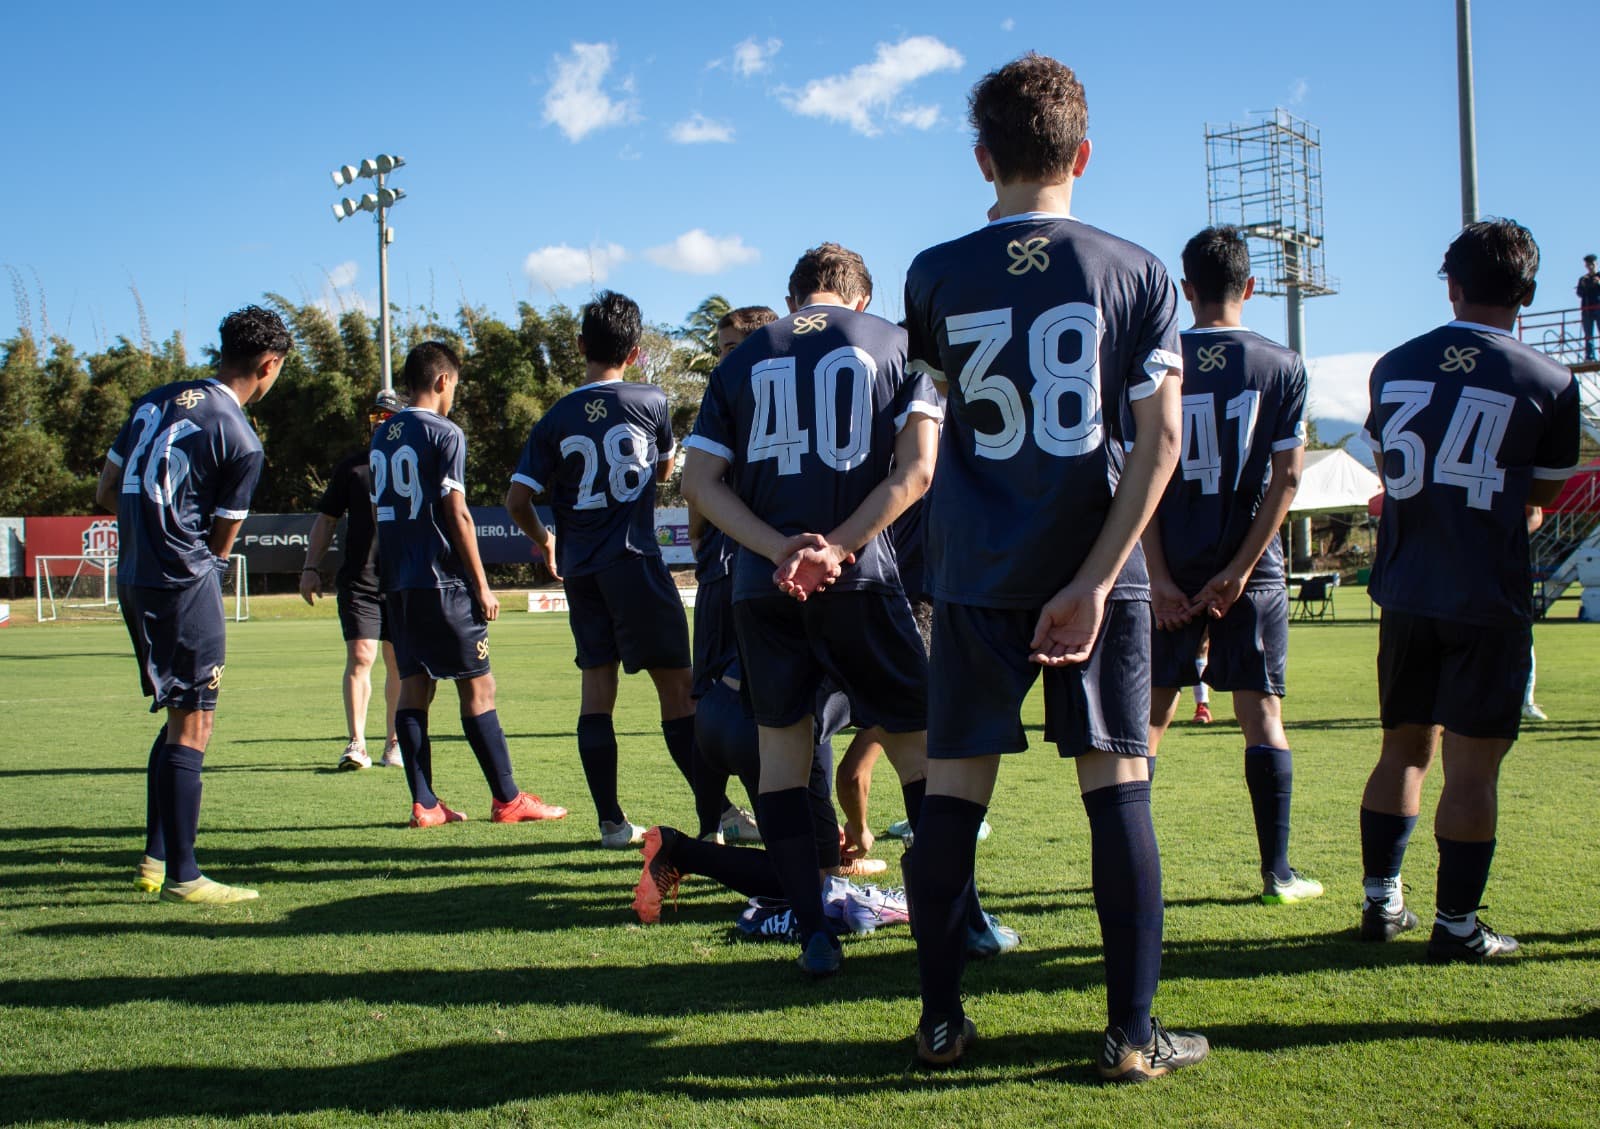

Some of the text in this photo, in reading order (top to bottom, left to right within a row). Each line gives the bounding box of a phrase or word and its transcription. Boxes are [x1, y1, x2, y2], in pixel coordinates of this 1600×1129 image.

[747, 346, 877, 475] 40
[945, 303, 1105, 460] 38
[122, 402, 202, 506] 26
[369, 445, 423, 521] 29
[560, 423, 653, 510] 28
[1181, 389, 1261, 495] 41
[1380, 380, 1517, 511] 34
[245, 534, 339, 546] PENAL
